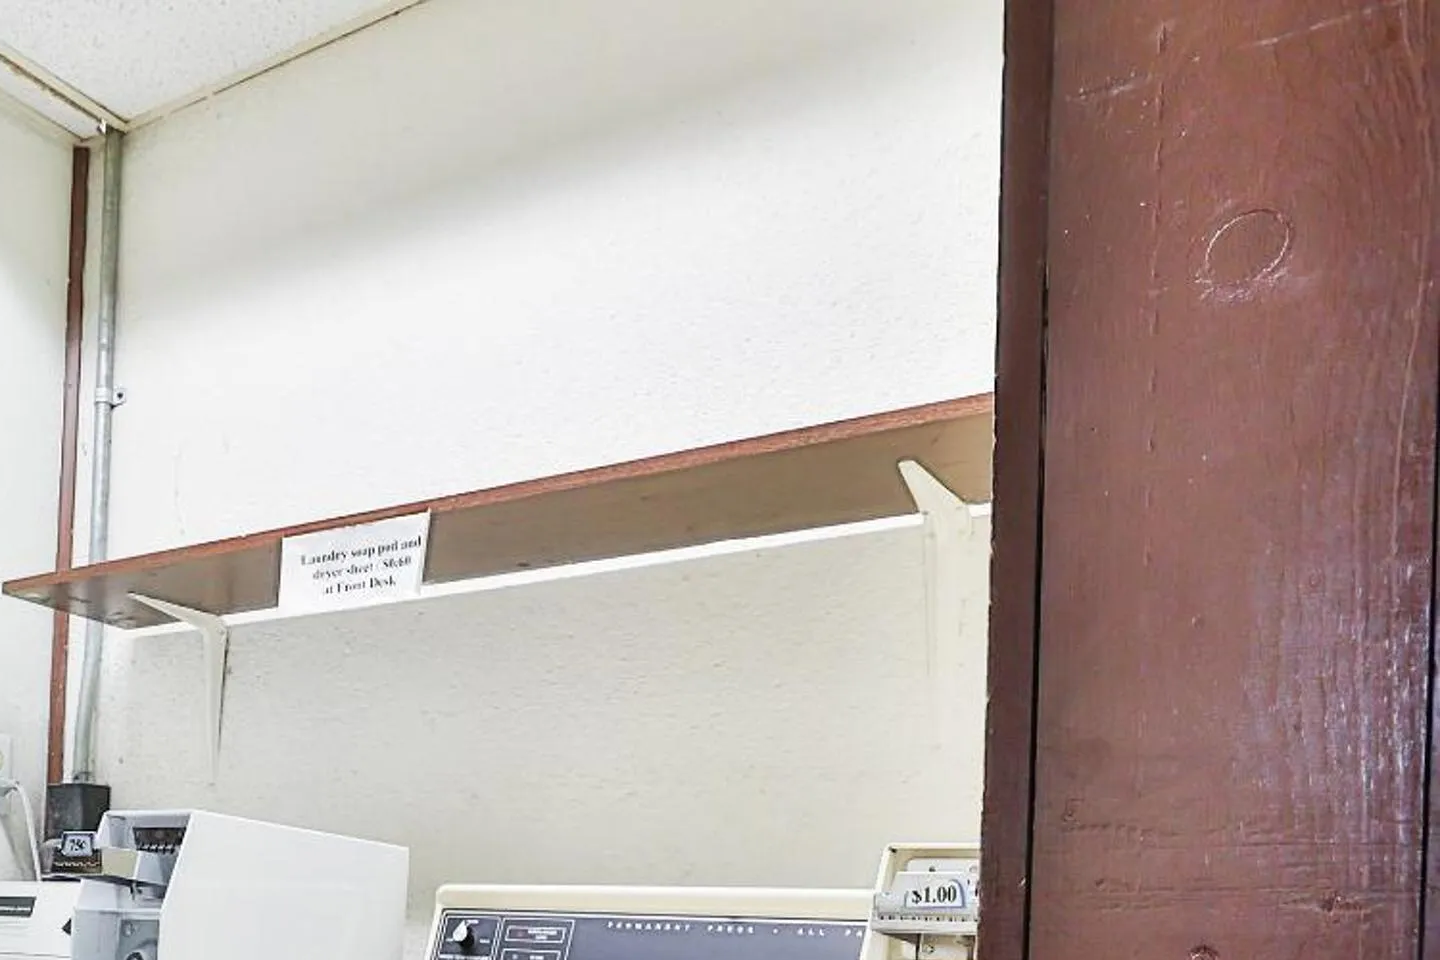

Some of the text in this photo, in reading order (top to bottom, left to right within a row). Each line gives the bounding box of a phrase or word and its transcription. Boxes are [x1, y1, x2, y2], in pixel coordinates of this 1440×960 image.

[300, 549, 347, 565] Laundry
[350, 547, 375, 559] soap
[400, 535, 421, 550] and
[336, 580, 366, 593] Front
[368, 575, 397, 589] Desk
[911, 885, 958, 904] $1.00
